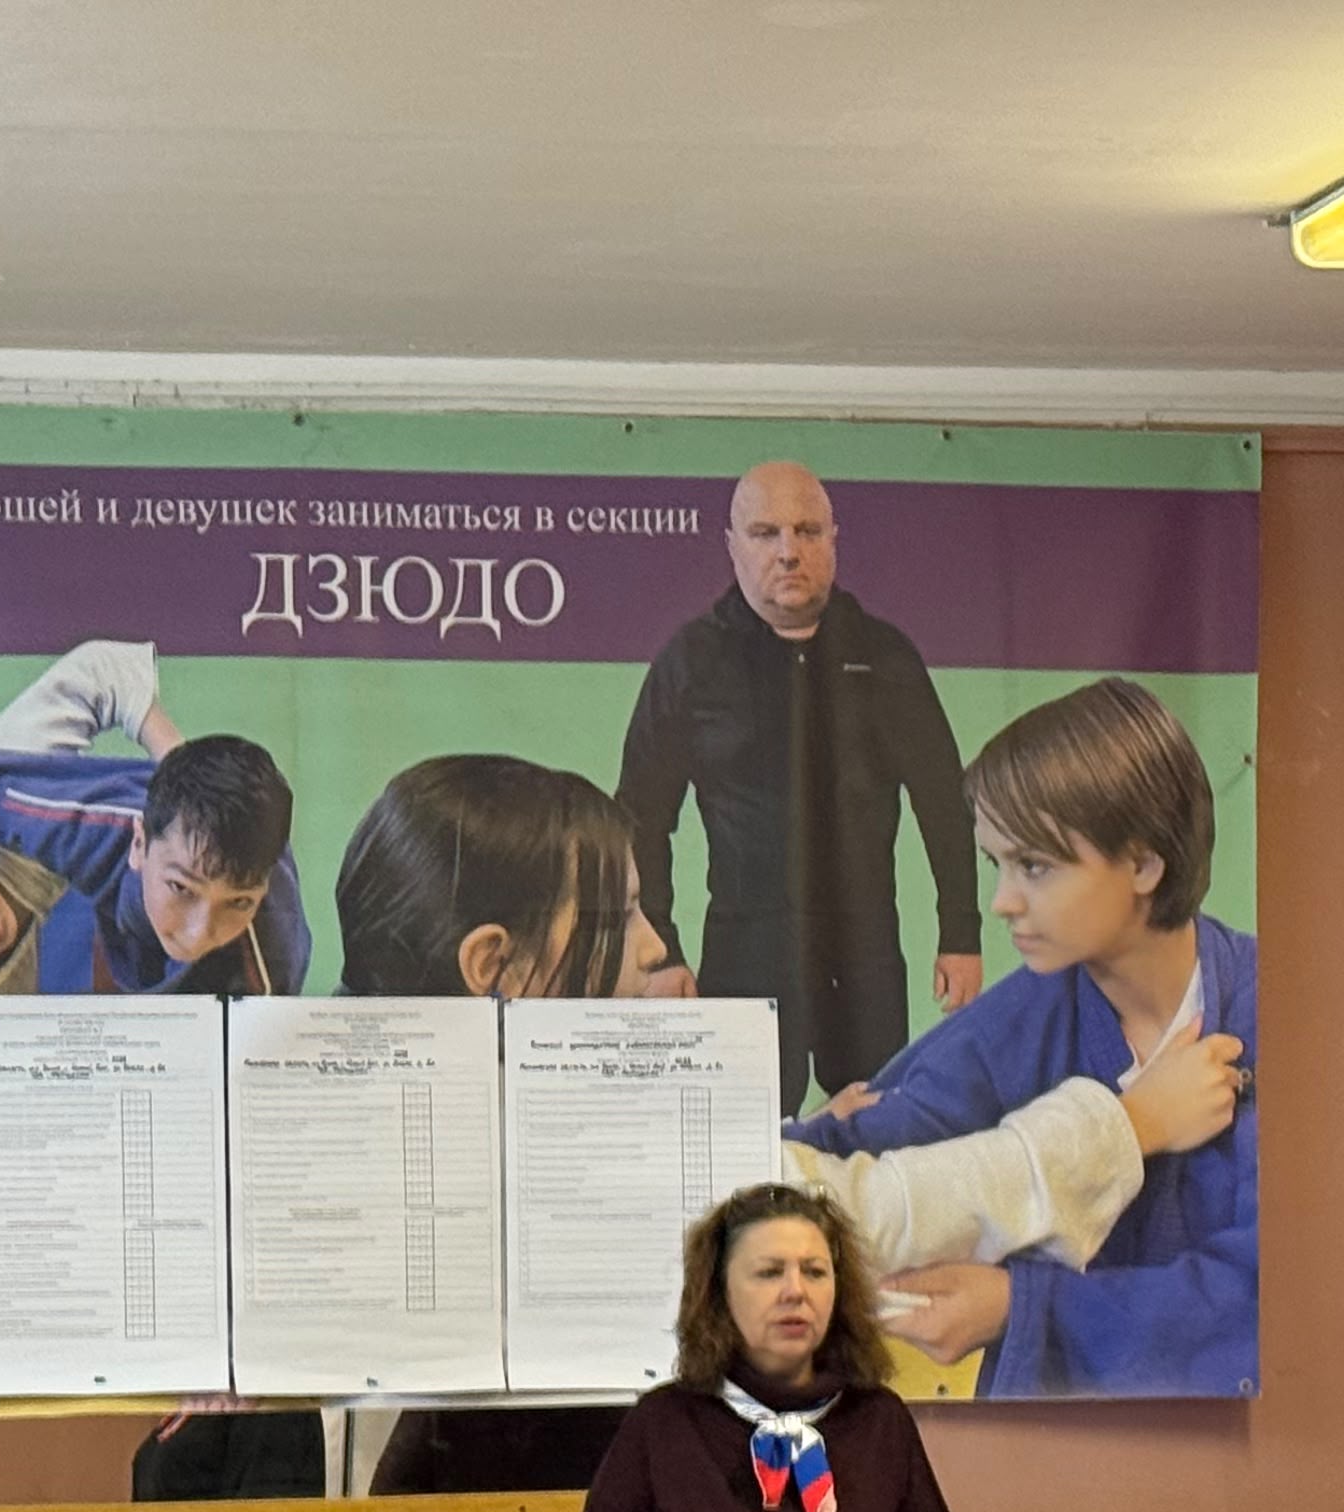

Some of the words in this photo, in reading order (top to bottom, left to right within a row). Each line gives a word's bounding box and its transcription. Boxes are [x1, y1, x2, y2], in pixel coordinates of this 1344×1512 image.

[96, 497, 119, 525] и
[131, 497, 297, 534] девушек
[307, 499, 521, 532] заниматься
[535, 505, 555, 531] в
[566, 504, 701, 537] секции
[241, 552, 566, 641] ДЗЮДО
